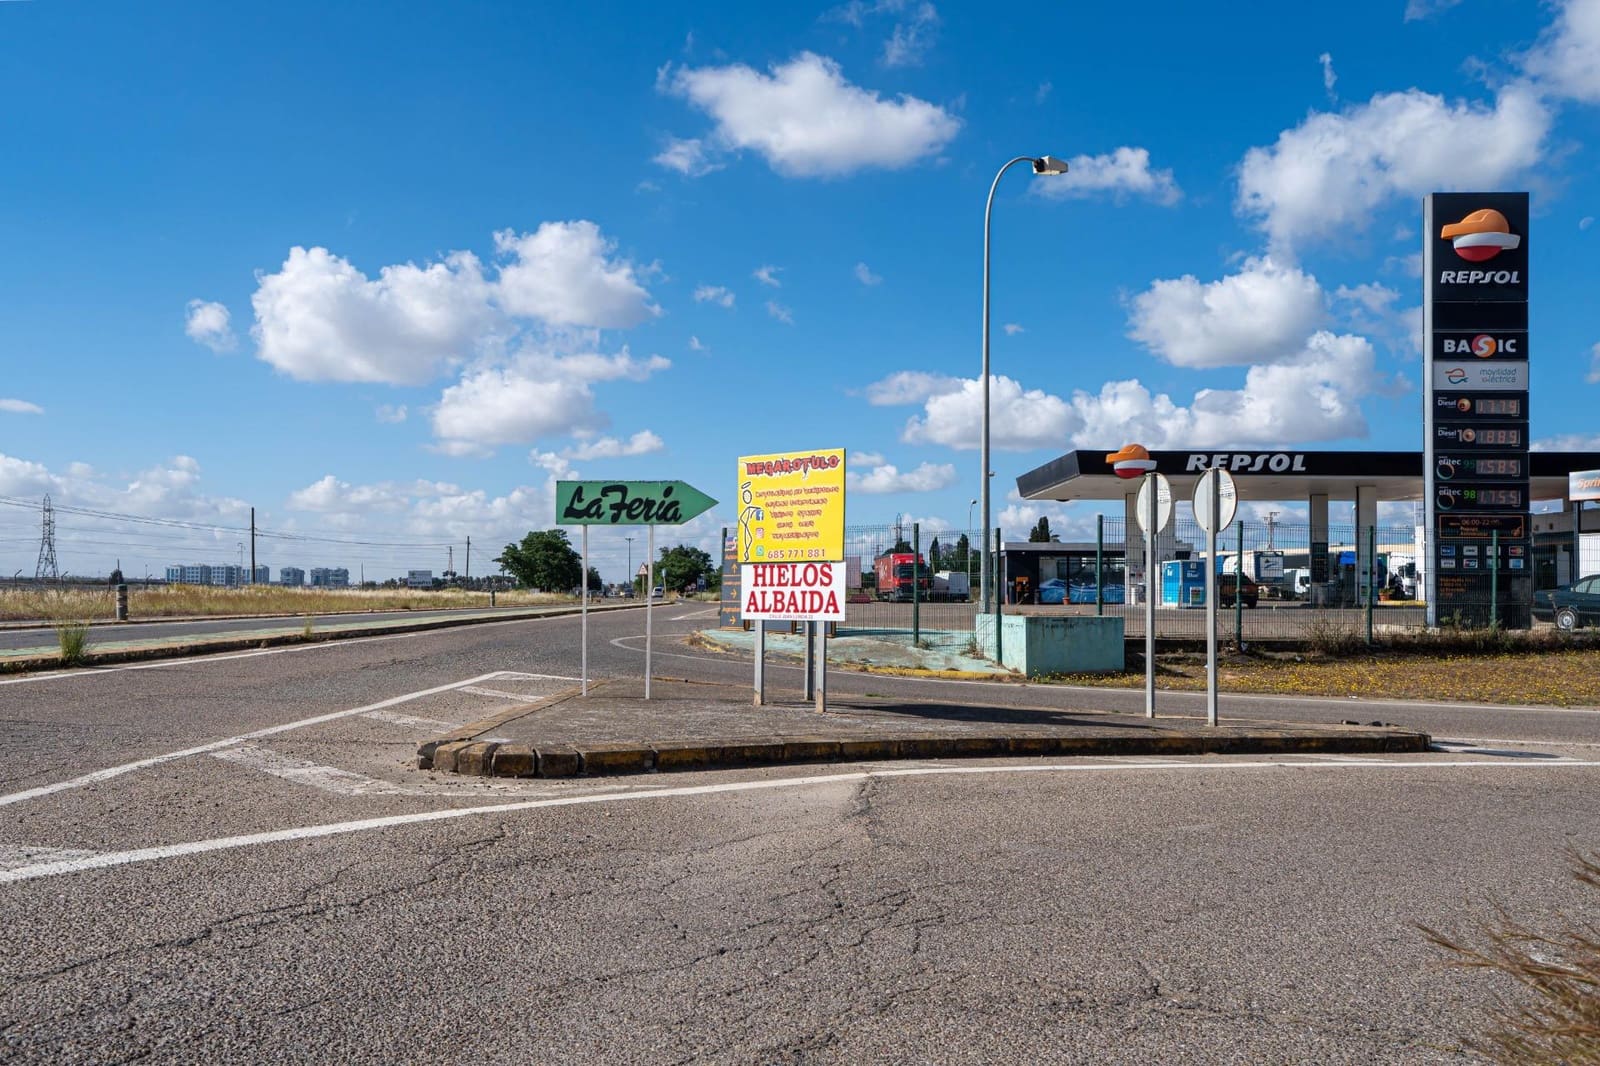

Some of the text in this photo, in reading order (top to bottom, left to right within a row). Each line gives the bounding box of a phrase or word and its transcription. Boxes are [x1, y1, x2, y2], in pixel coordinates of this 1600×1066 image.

[1440, 271, 1520, 284] REPSOL
[1443, 336, 1517, 355] BASIC
[1186, 453, 1306, 472] REPSOL
[563, 485, 682, 523] La Feria
[1463, 490, 1476, 499] 98
[767, 549, 825, 559] 685 771 881
[752, 563, 833, 587] HIELOS
[745, 590, 840, 613] ALBAIDA
